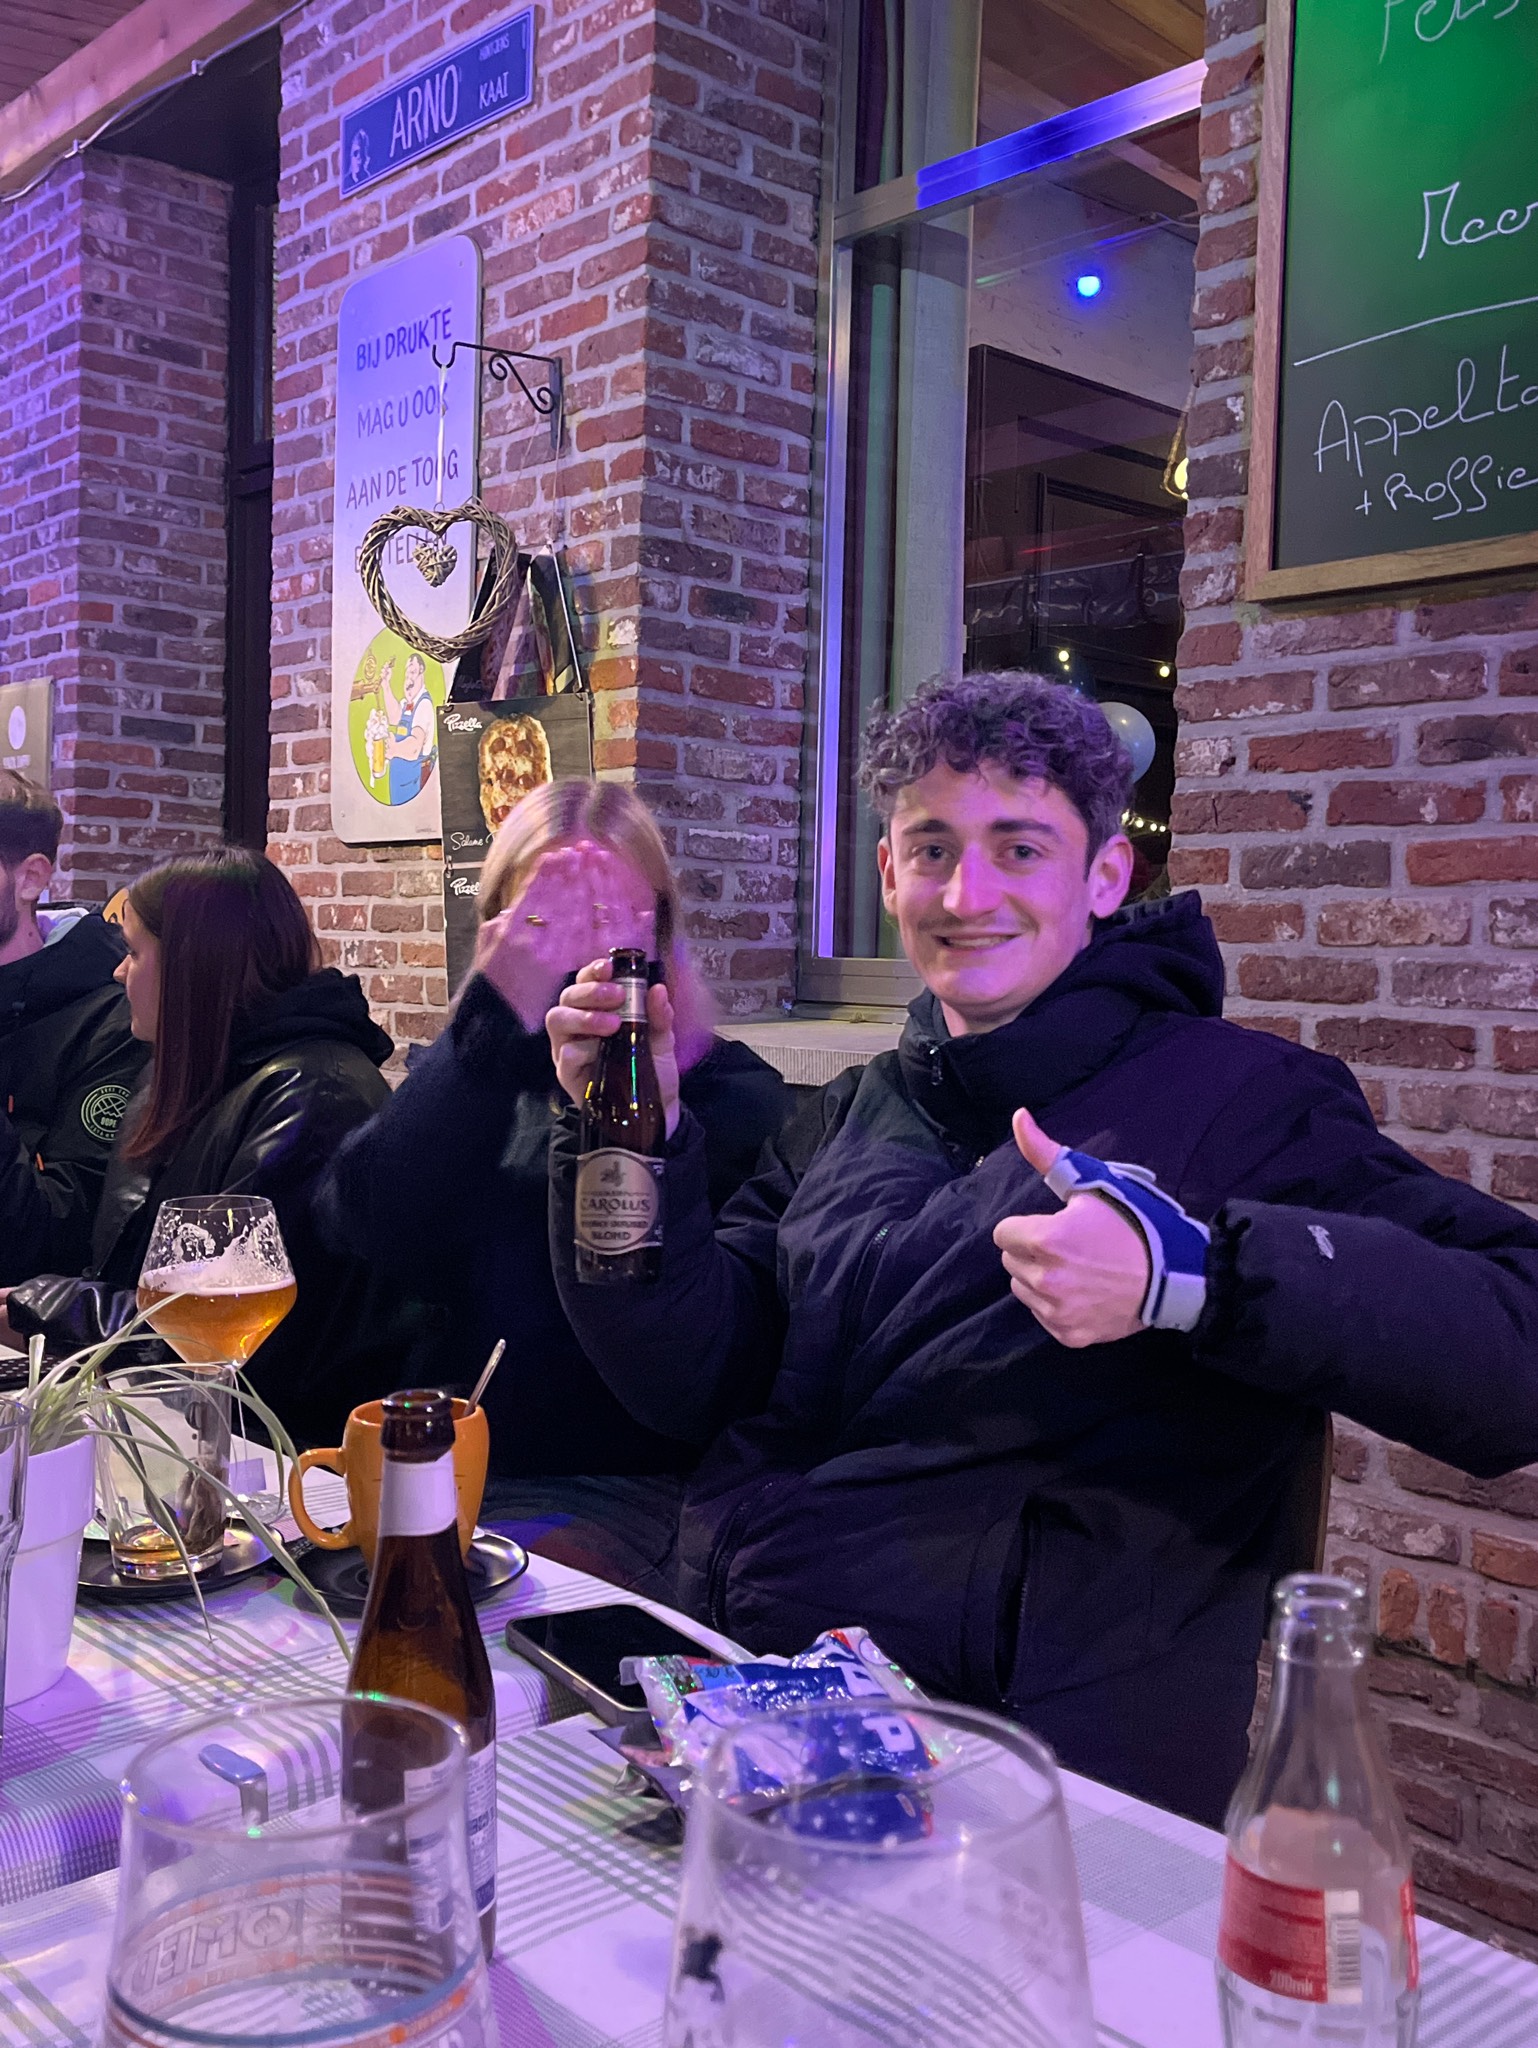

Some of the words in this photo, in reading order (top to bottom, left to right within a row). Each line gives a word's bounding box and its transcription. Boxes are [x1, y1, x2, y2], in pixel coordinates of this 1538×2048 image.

[389, 65, 459, 158] ARNO
[479, 71, 509, 110] KAAI
[356, 338, 380, 372] BIJ
[385, 307, 452, 360] DRUKTE
[357, 401, 394, 439] MAG
[398, 396, 409, 427] U
[412, 382, 449, 419] OOK
[346, 472, 380, 510] AAN
[386, 465, 407, 497] DE
[411, 449, 459, 488] TOOG
[443, 713, 482, 732] Pizzella
[449, 877, 480, 896] Pizzel
